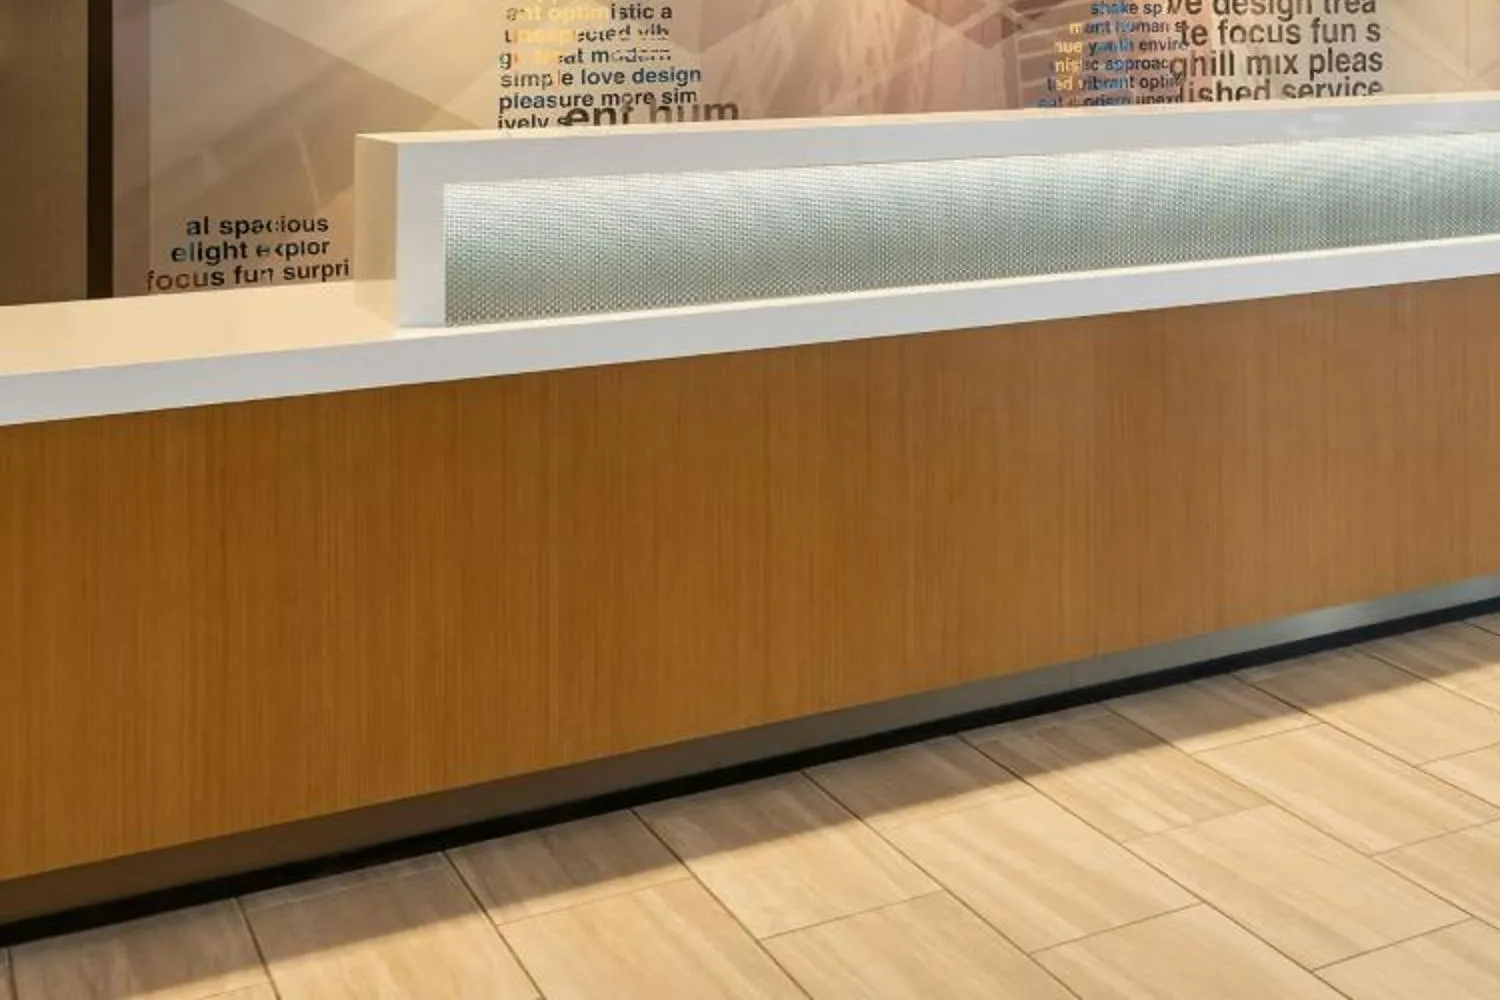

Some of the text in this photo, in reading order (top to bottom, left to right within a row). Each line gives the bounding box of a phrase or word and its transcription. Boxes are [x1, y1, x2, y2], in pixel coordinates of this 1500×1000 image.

[660, 5, 673, 20] a
[1143, 3, 1163, 17] sp
[1217, 18, 1301, 45] focus
[1310, 17, 1357, 44] fun
[1365, 22, 1381, 42] s
[1246, 52, 1300, 76] mix
[1308, 47, 1384, 80] pleas
[500, 66, 702, 90] simple love design
[1280, 75, 1384, 100] service
[499, 86, 698, 113] pleasure more sim
[186, 215, 330, 240] al spacious
[171, 239, 250, 267] elight
[145, 269, 226, 292] focus
[282, 258, 350, 283] surpri
